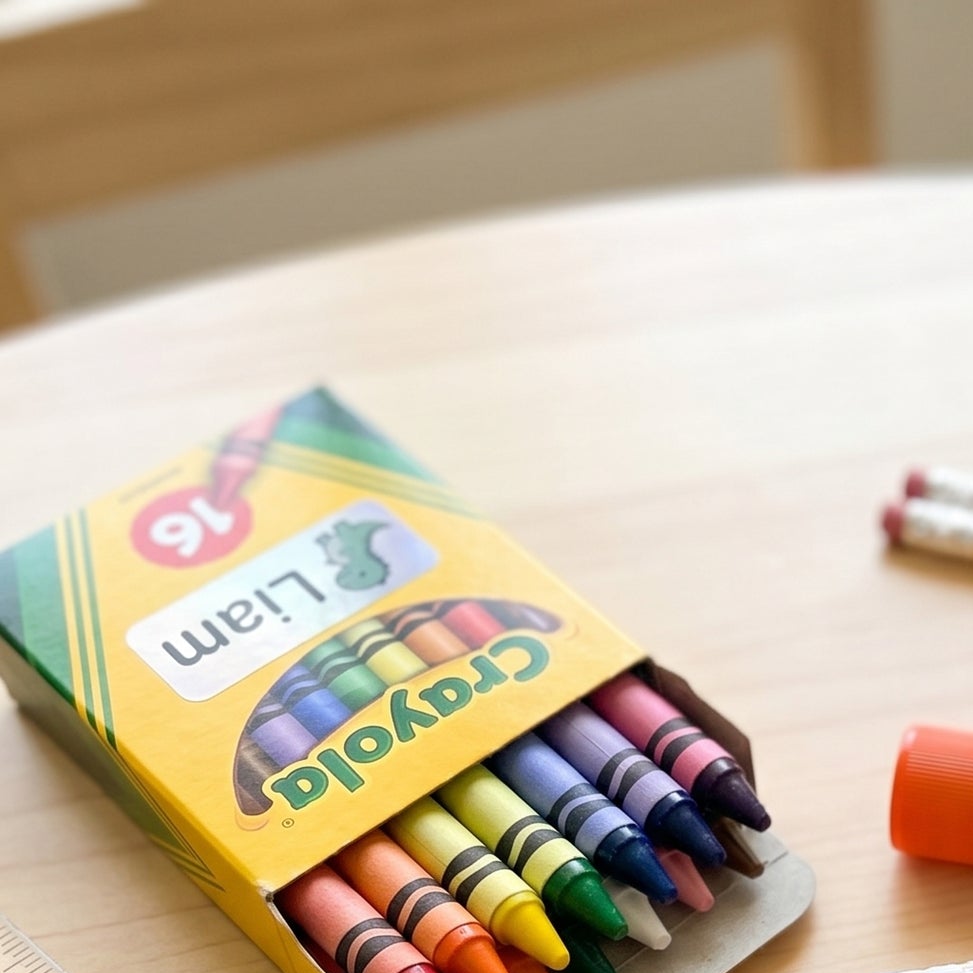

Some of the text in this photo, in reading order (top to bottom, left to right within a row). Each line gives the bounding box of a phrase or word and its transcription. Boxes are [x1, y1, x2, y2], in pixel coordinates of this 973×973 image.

[150, 496, 236, 558] 16
[161, 570, 325, 668] Liam
[271, 635, 550, 810] Crayola
